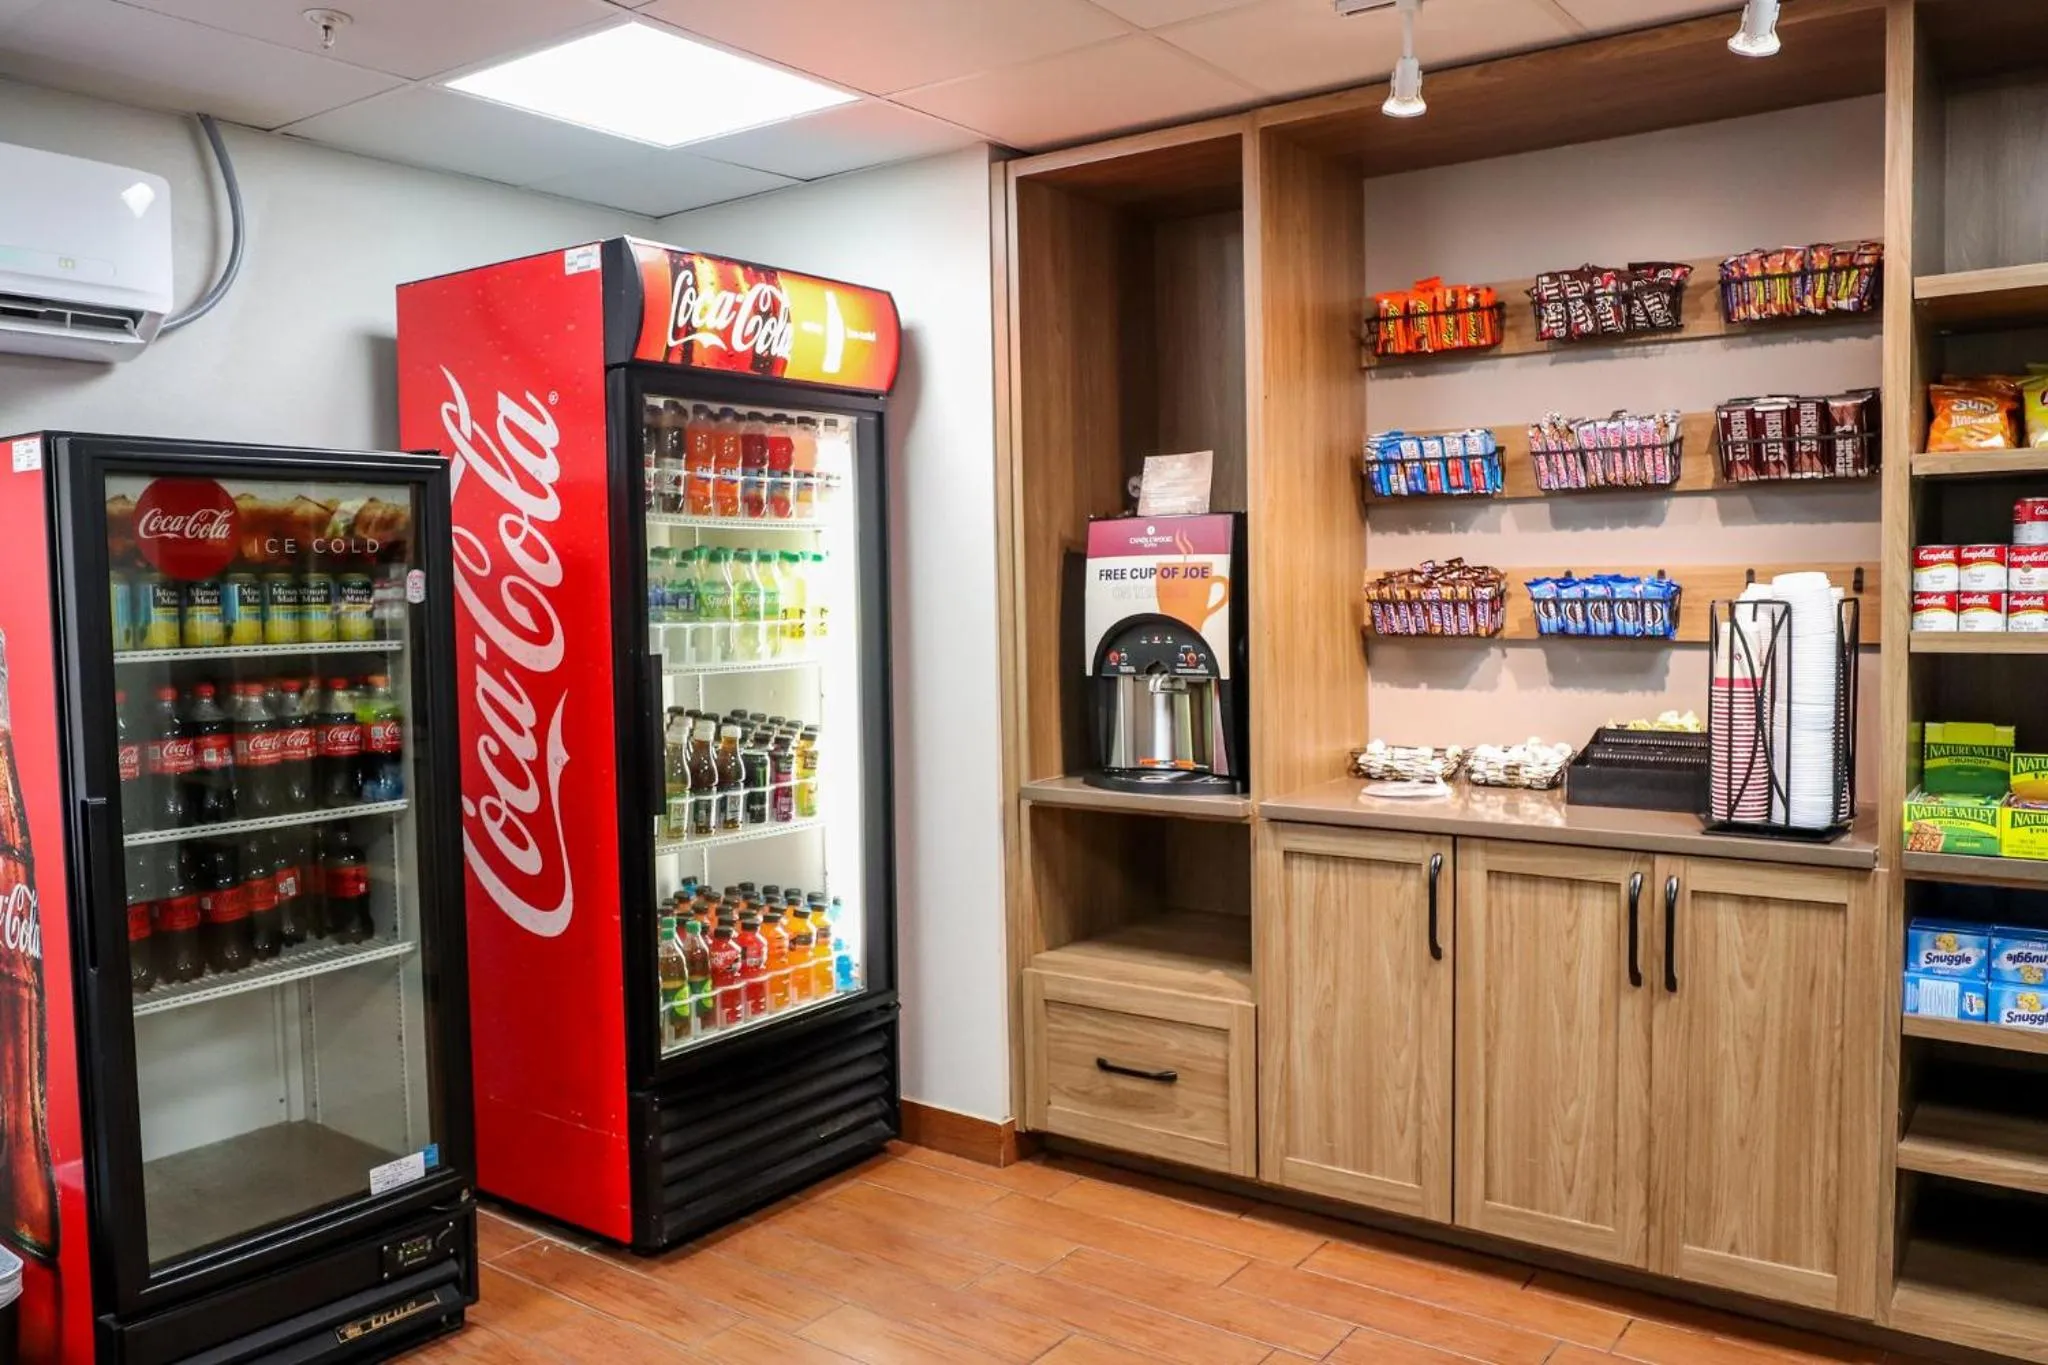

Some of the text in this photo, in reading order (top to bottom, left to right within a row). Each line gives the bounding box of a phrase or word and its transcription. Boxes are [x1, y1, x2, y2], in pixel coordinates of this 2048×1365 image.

[667, 269, 795, 357] Coca-Cola
[139, 508, 235, 540] Coca-Cola
[254, 538, 380, 554] ICE COLD
[1099, 566, 1210, 581] FREE CUP OF JOE
[440, 364, 574, 938] Coca-Cola
[1929, 744, 2011, 761] NATURE VALLEY
[2016, 757, 2048, 773] NATU
[1910, 805, 1995, 825] NATURE VALLEY
[2013, 813, 2048, 827] NATUR
[1924, 952, 1972, 965] Snuggle
[2006, 951, 2048, 965] nuggle
[2005, 1011, 2048, 1026] Snuggl
